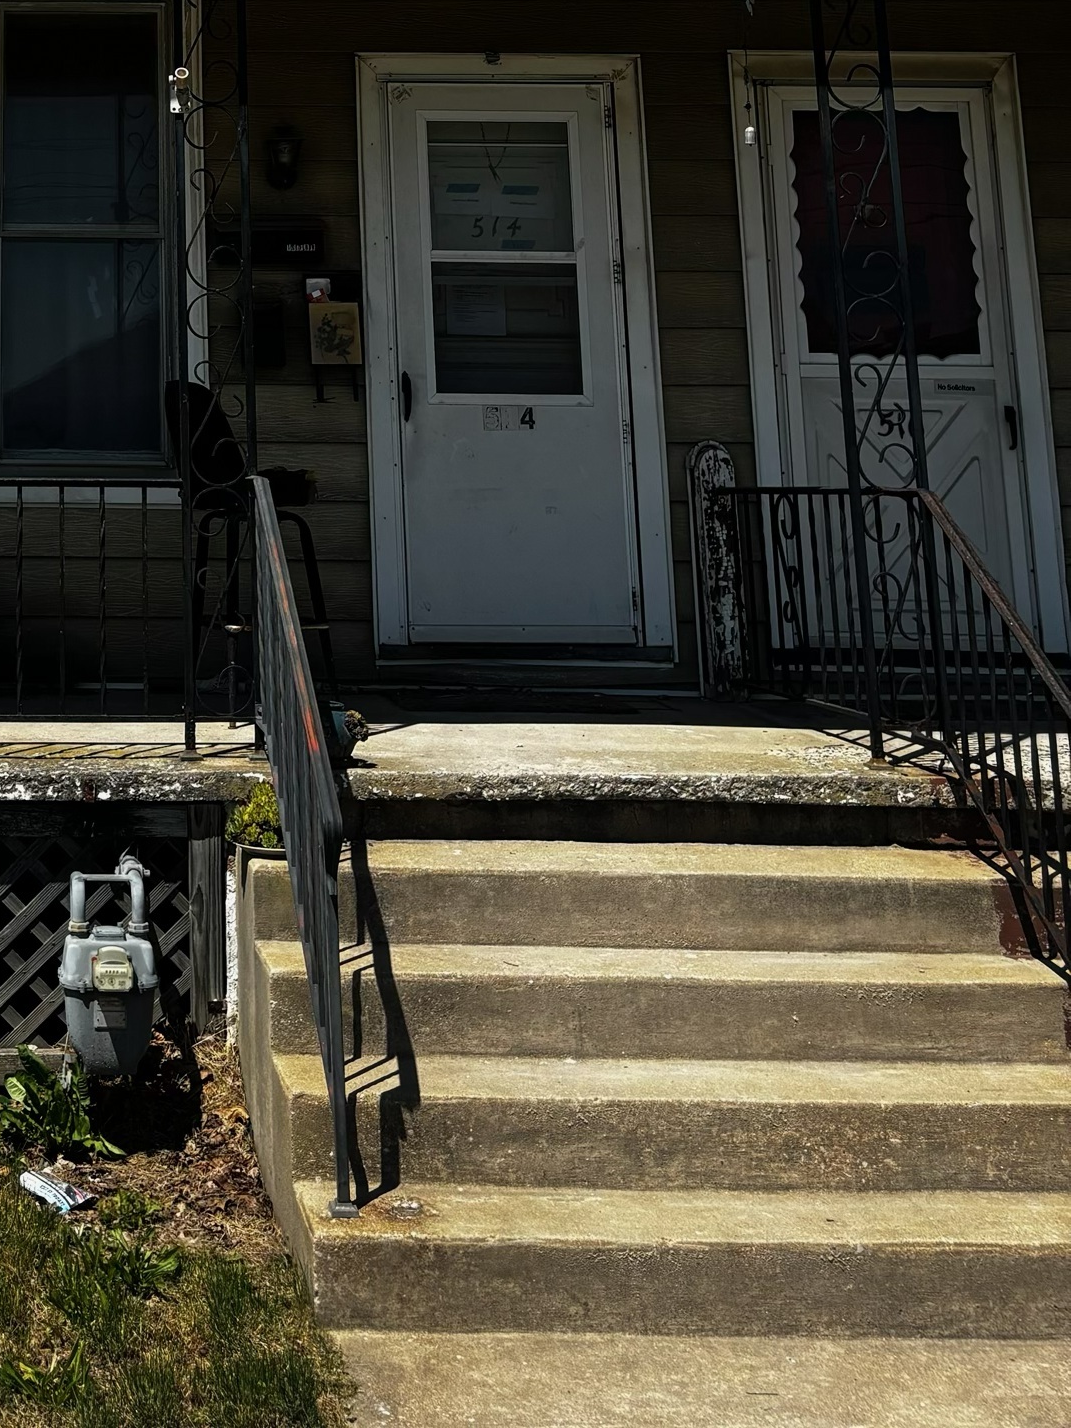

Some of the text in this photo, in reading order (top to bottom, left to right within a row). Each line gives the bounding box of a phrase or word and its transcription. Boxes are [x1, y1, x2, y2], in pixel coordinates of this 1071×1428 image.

[471, 216, 521, 238] 514
[937, 383, 976, 392] No Solicitors
[877, 411, 923, 439] 51
